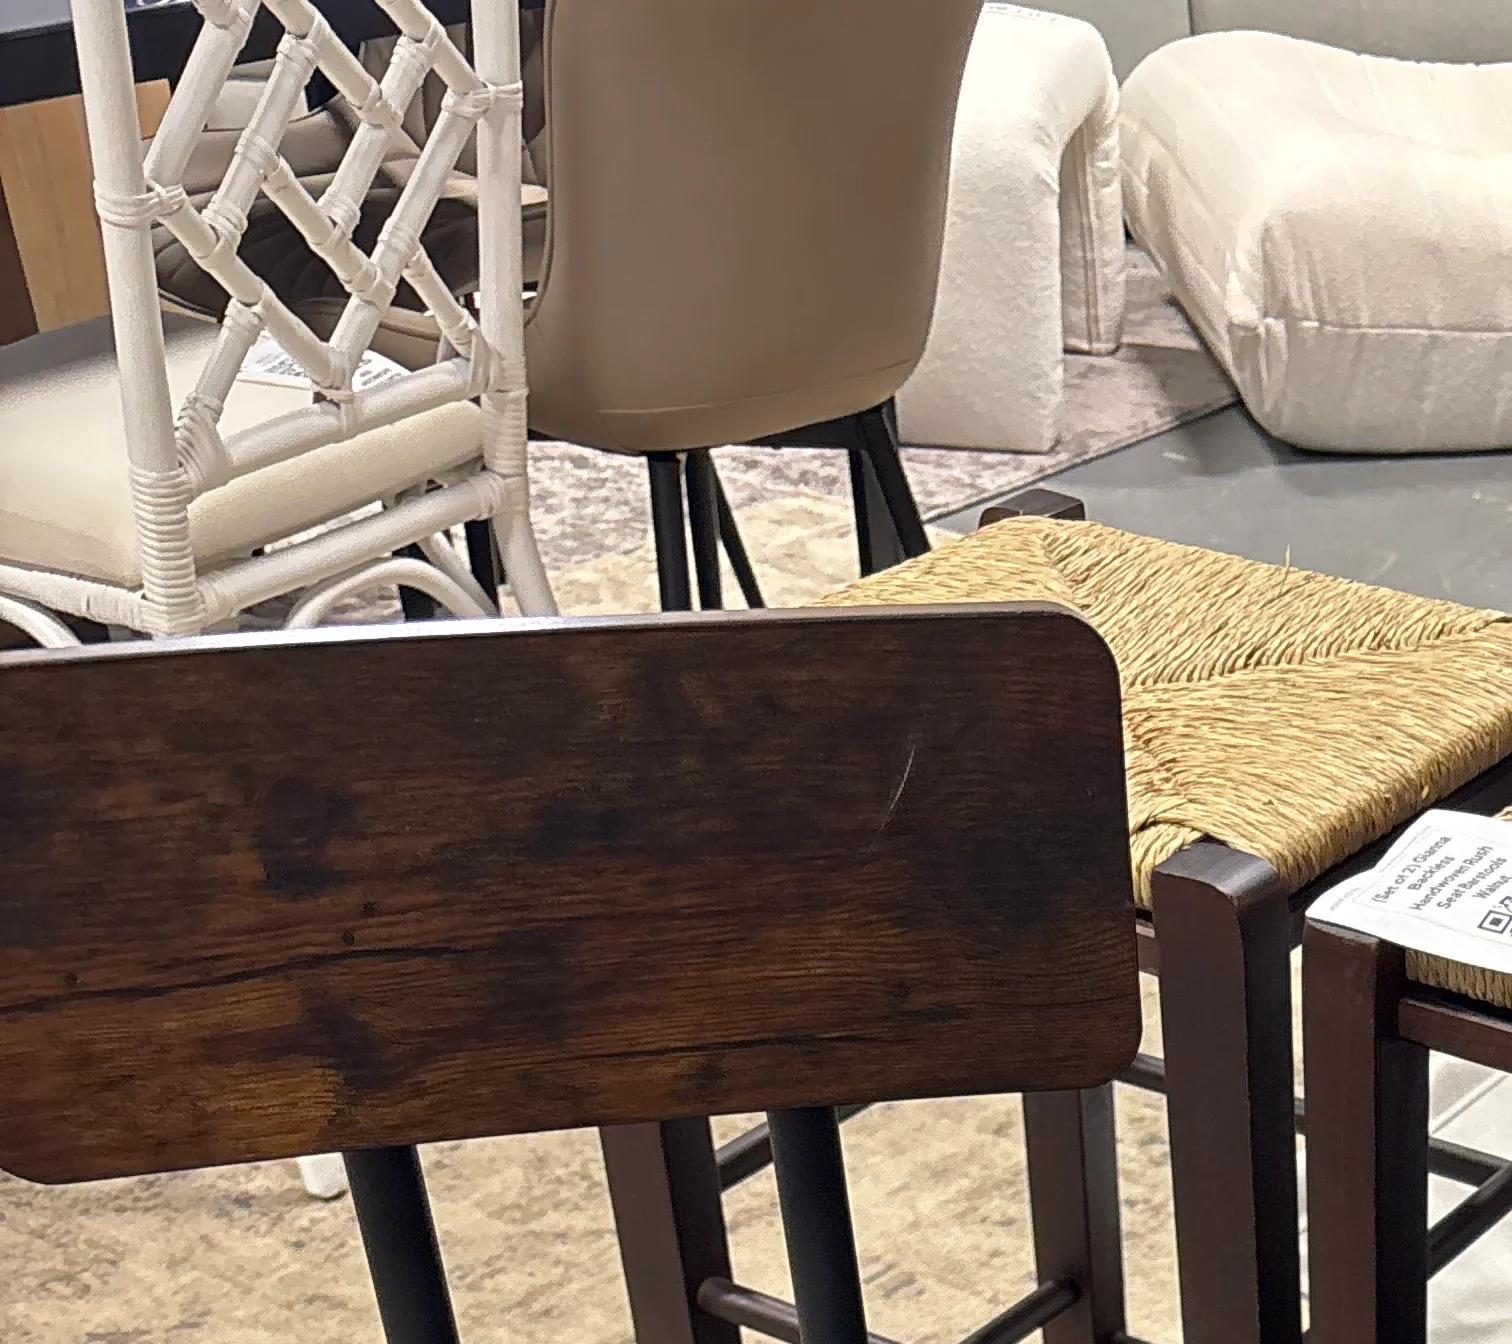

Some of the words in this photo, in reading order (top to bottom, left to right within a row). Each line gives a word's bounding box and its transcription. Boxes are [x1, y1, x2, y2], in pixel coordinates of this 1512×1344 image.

[1412, 836, 1452, 863] Gianna
[1407, 856, 1455, 891] Backless
[1409, 864, 1471, 910] Handwoven
[1462, 845, 1494, 866] Rush
[1436, 888, 1466, 909] Seat
[1458, 856, 1508, 890] Barstools
[1472, 875, 1512, 900] Walnut
